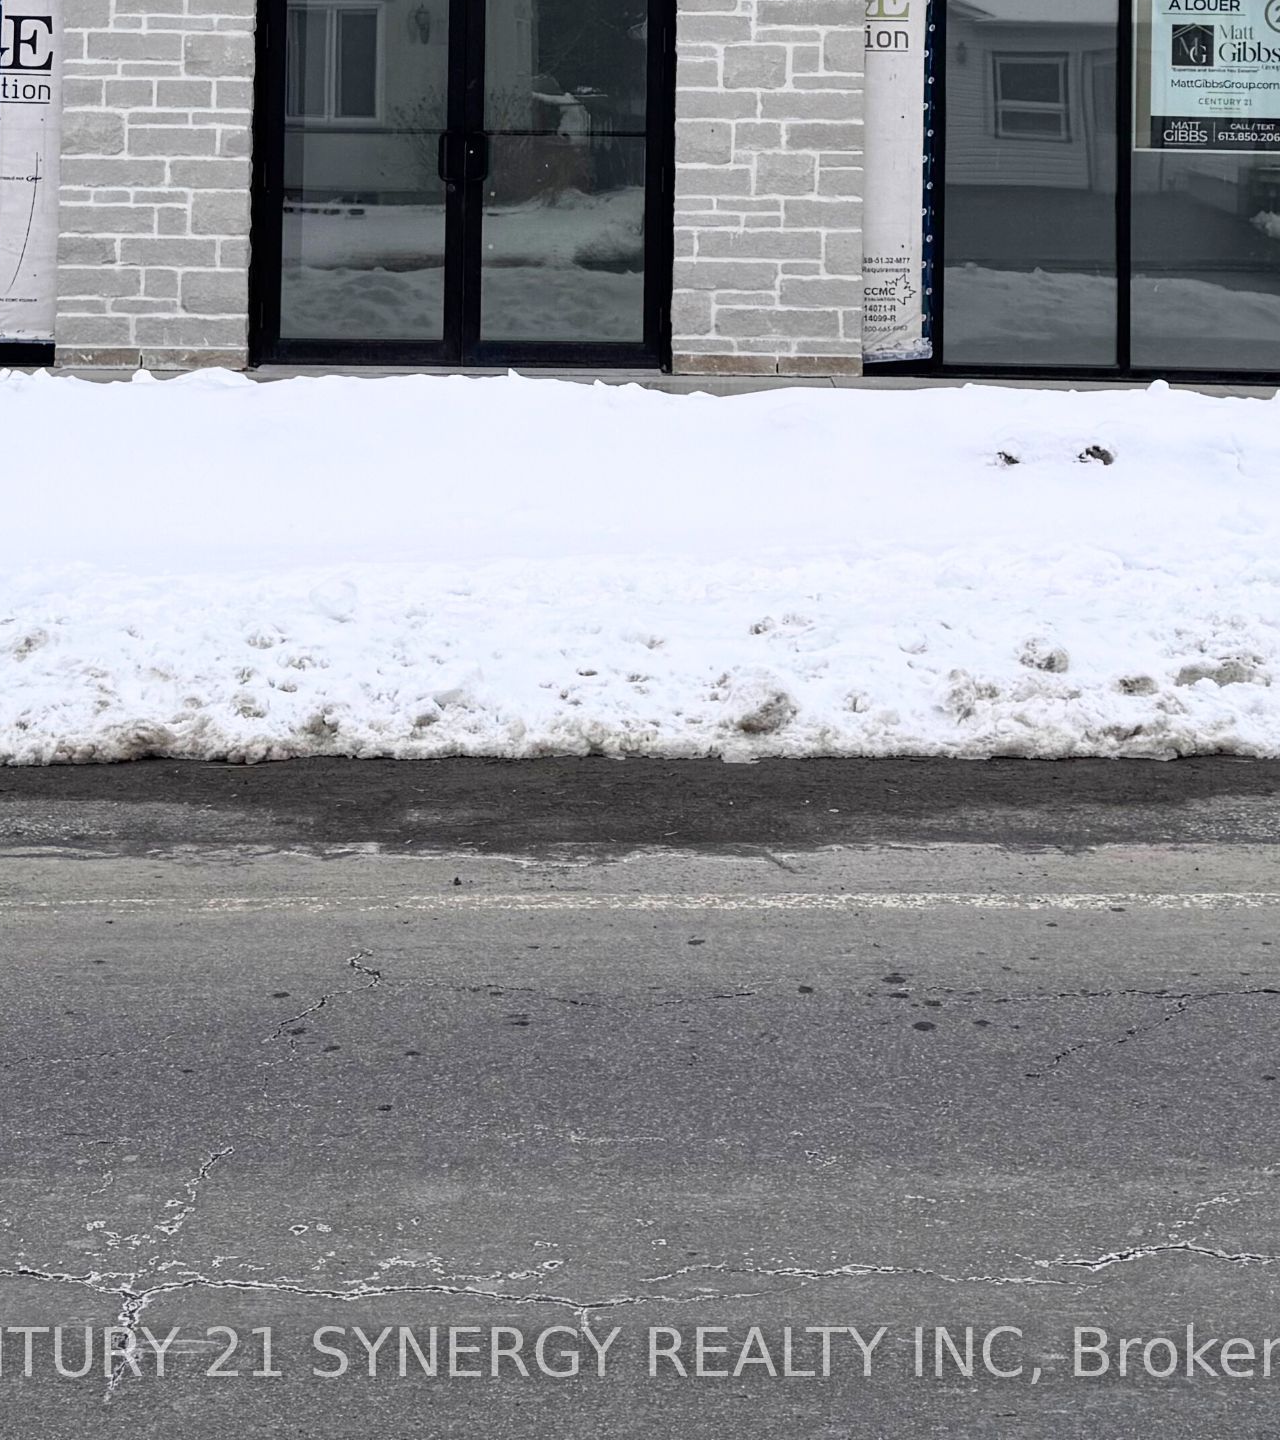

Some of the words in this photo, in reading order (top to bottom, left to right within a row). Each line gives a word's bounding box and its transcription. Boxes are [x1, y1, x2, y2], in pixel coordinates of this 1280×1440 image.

[1220, 24, 1254, 41] Matt
[1171, 79, 1280, 91] MattGibbsGroup.com
[1243, 98, 1253, 106] 21
[1171, 121, 1201, 131] MATT
[1163, 131, 1208, 142] GIBBS
[863, 287, 896, 296] CCMC
